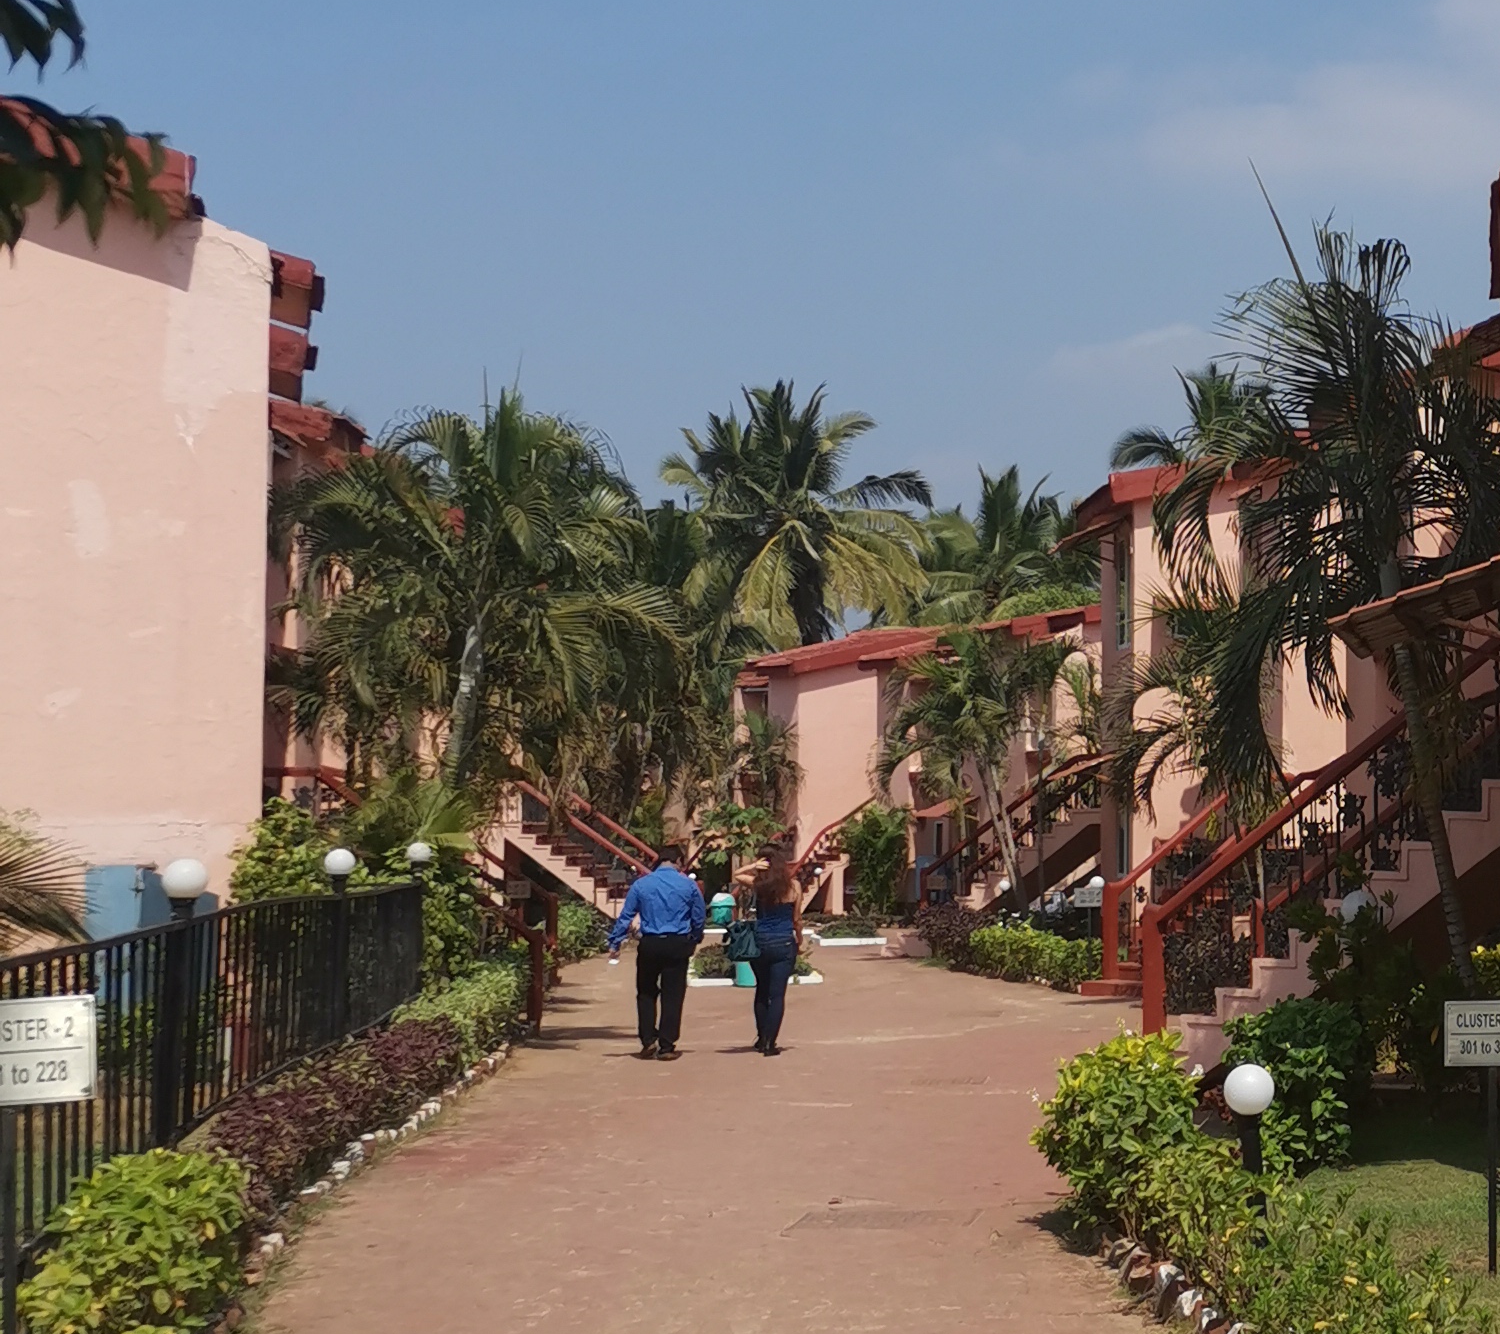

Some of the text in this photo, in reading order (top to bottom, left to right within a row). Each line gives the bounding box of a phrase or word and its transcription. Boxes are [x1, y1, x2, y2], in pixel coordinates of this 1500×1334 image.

[1, 1018, 48, 1042] STER
[1460, 1040, 1477, 1054] 301
[1481, 1041, 1491, 1053] to
[11, 1065, 29, 1085] to
[36, 1060, 68, 1083] 228
